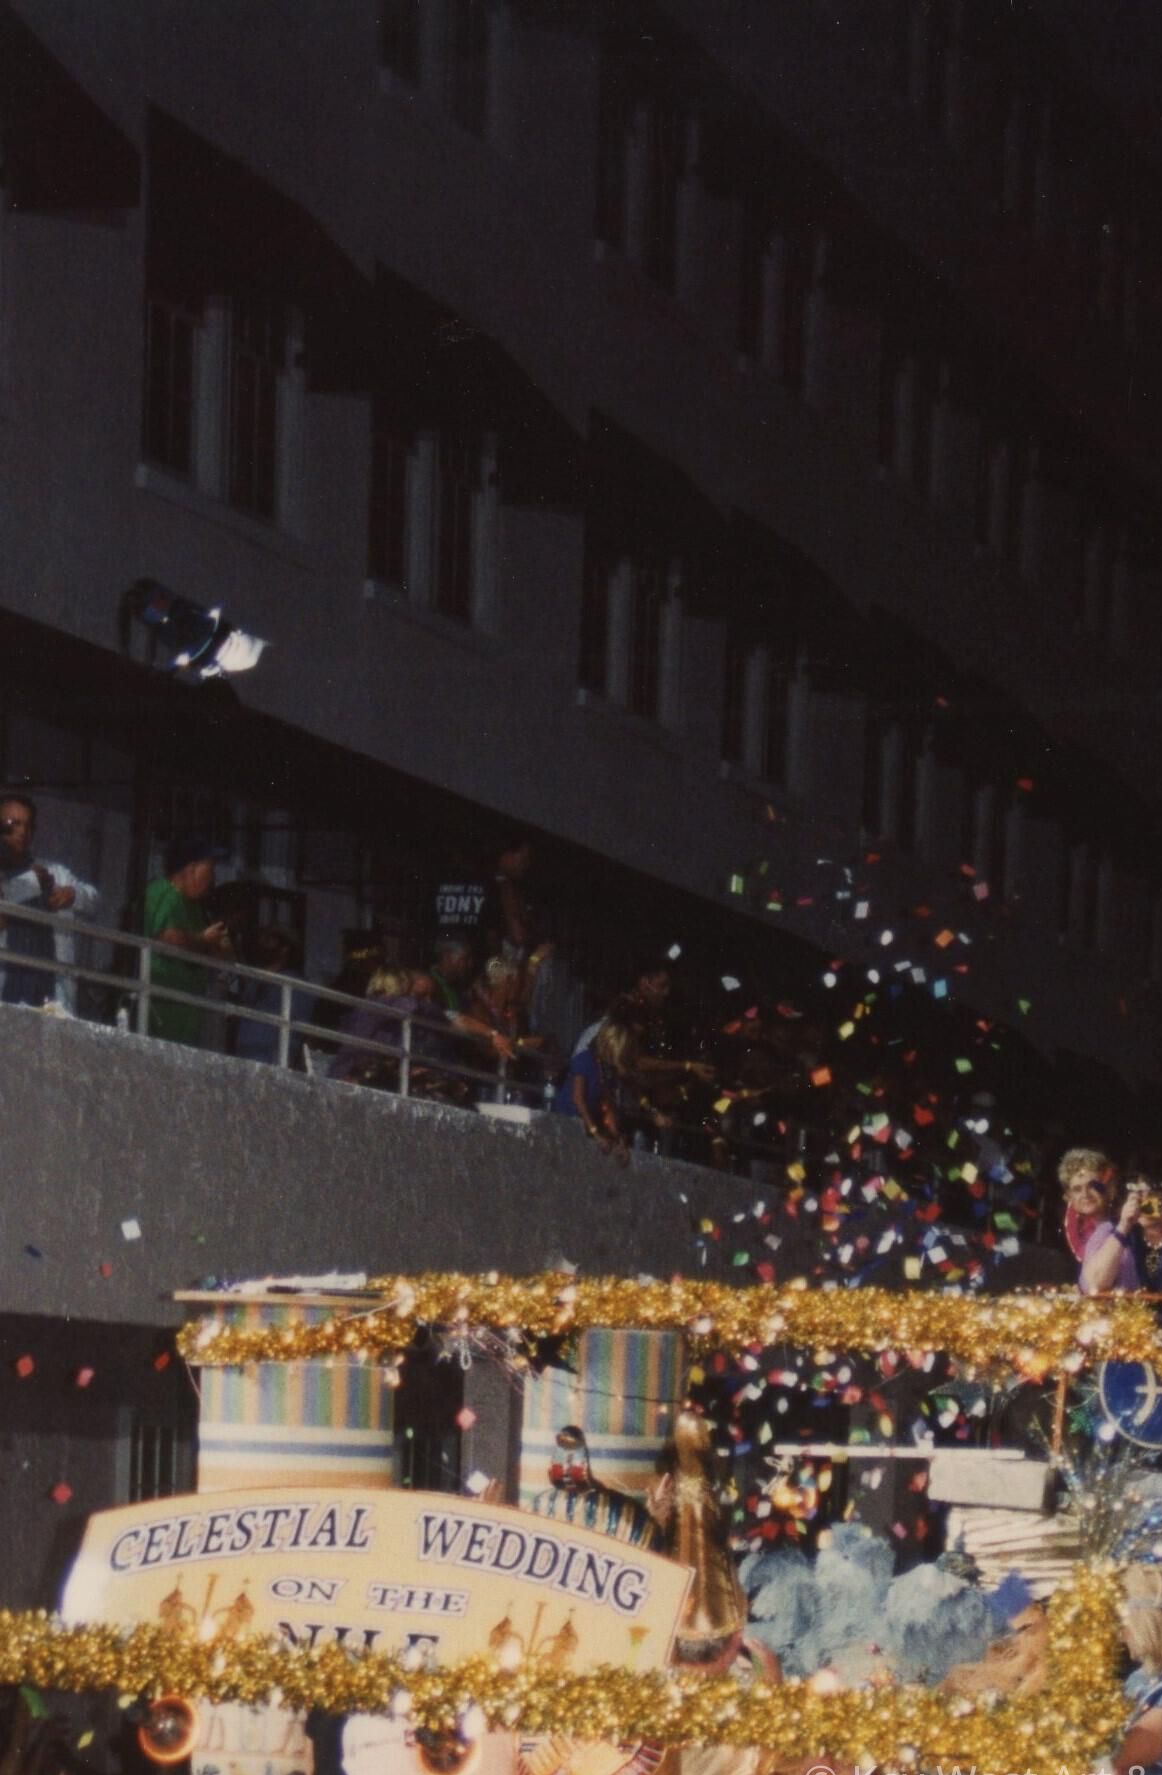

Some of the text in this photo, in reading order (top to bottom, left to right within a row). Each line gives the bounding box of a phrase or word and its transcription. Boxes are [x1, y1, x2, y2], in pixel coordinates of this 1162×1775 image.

[435, 895, 485, 914] FDNY
[109, 1507, 645, 1611] CELESTIAL WEDDING
[271, 1579, 466, 1613] ON THE
